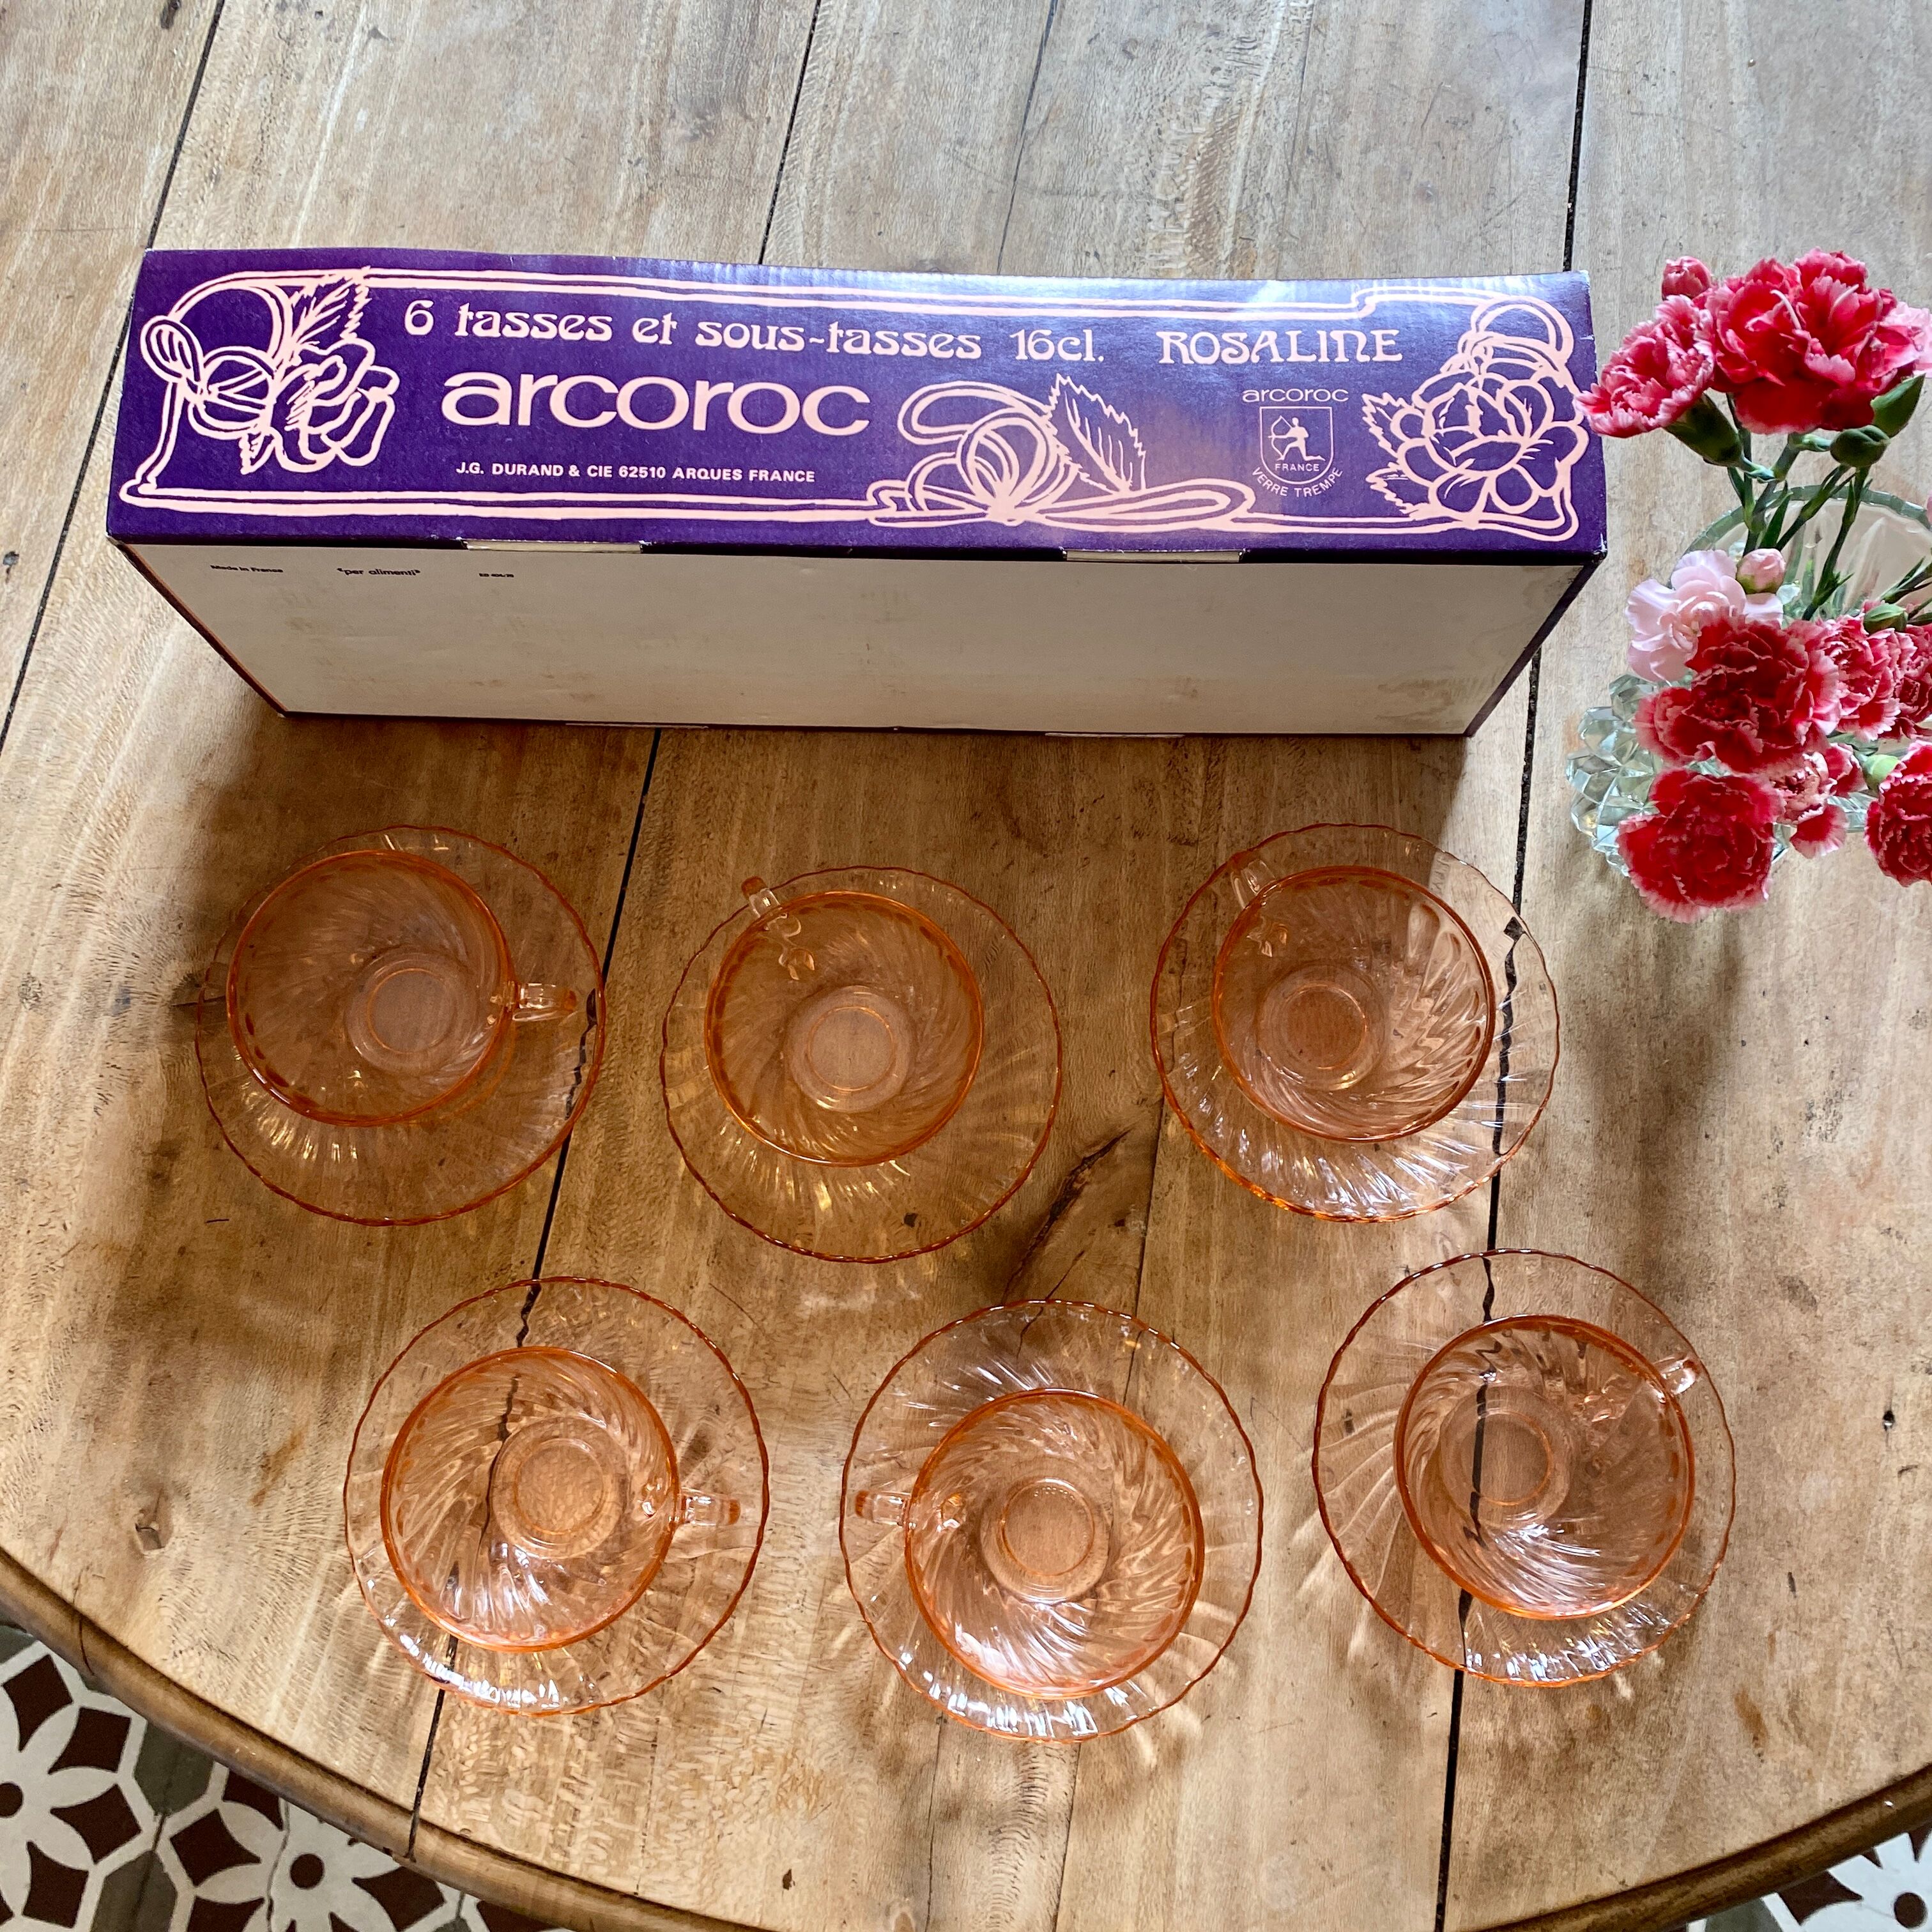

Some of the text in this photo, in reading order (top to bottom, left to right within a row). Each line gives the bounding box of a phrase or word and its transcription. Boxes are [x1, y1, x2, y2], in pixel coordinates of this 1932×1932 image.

[404, 300, 1104, 362] 6 tasses et sous-tasses 16cl.
[1155, 329, 1403, 365] ROSALINE
[441, 372, 870, 436] arcoroc
[1242, 388, 1349, 402] arcoroc
[456, 461, 815, 482] J.G. DURAND & CIE 62510 ARQUES FRANCE
[1252, 467, 1343, 497] VERRE TREMPE
[1275, 463, 1320, 471] FRANCE
